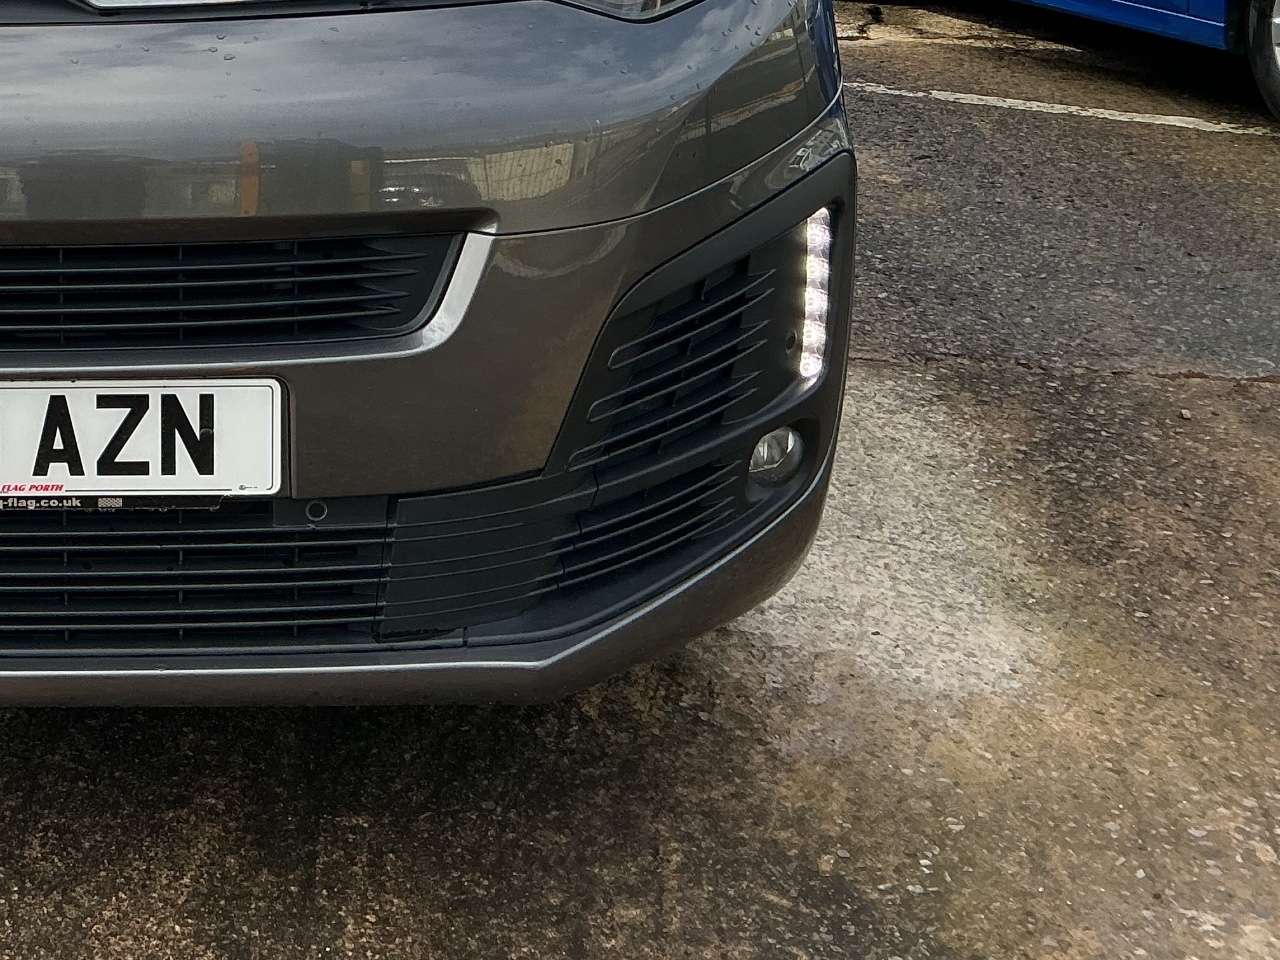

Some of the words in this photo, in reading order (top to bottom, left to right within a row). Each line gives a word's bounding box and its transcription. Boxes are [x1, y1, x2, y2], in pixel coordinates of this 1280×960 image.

[32, 393, 215, 477] AZN
[1, 484, 26, 492] FLAG
[28, 484, 65, 492] PORTH
